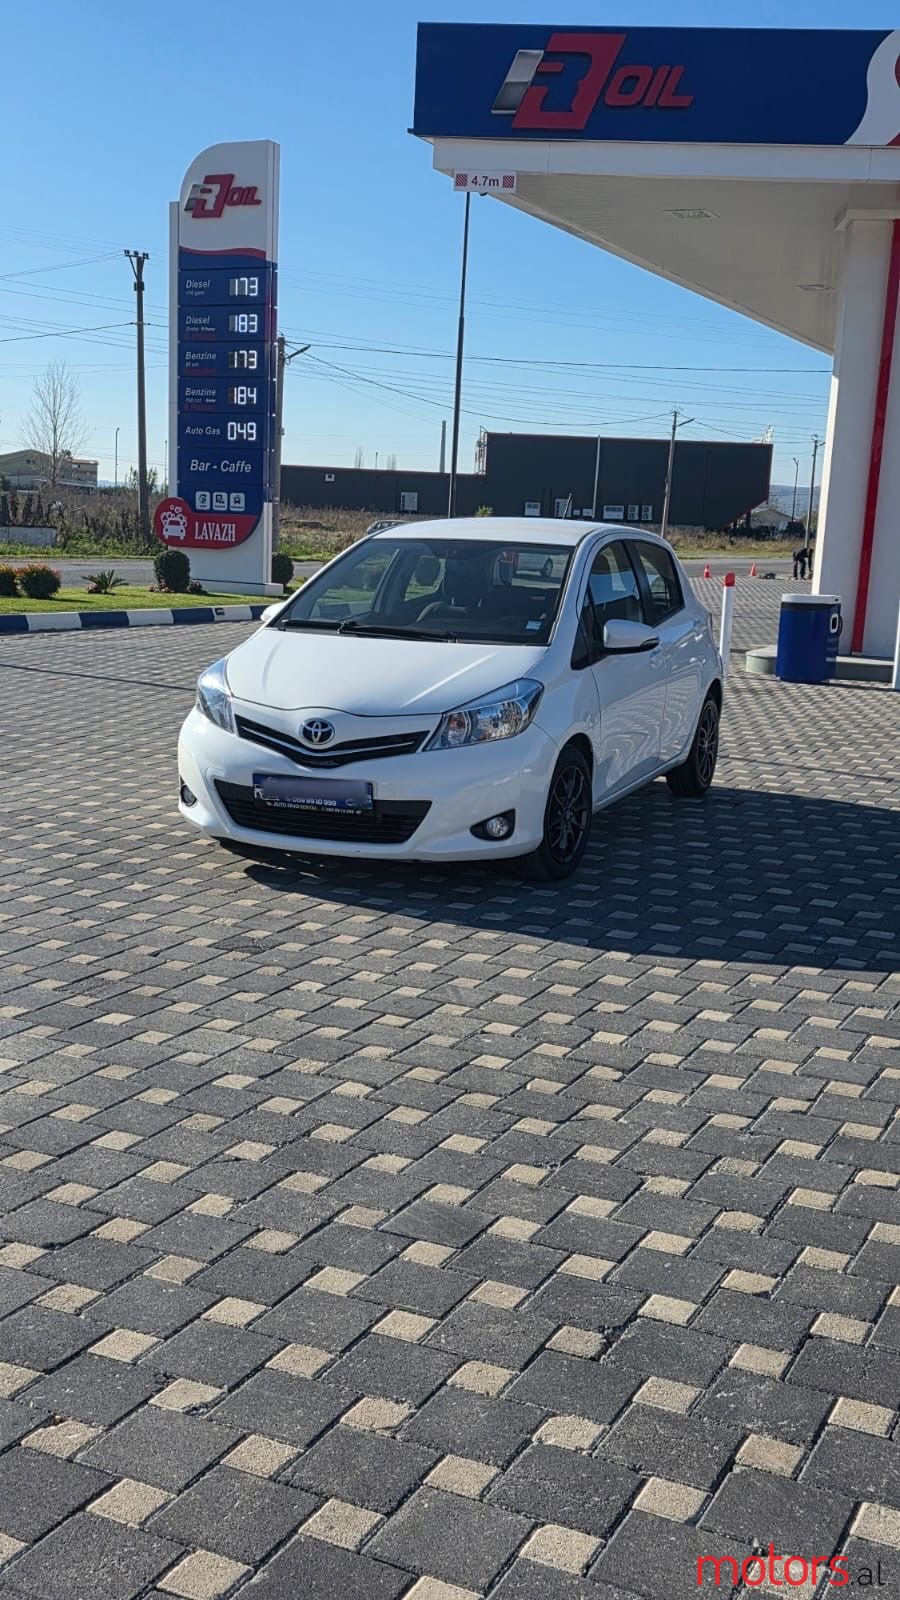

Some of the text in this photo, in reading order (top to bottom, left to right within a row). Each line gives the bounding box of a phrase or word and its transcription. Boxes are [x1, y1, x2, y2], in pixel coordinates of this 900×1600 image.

[603, 65, 694, 107] OIL
[471, 175, 499, 187] 4.7m
[226, 186, 262, 206] OIL
[185, 277, 258, 296] Diesel 173
[185, 314, 258, 333] Diesel 183
[185, 350, 257, 369] Benzine 173
[185, 386, 257, 405] Benzine 184
[185, 421, 257, 440] Auto Gas 049
[190, 459, 211, 472] Bar
[220, 460, 252, 473] Caffe
[195, 521, 236, 542] LAVAZH
